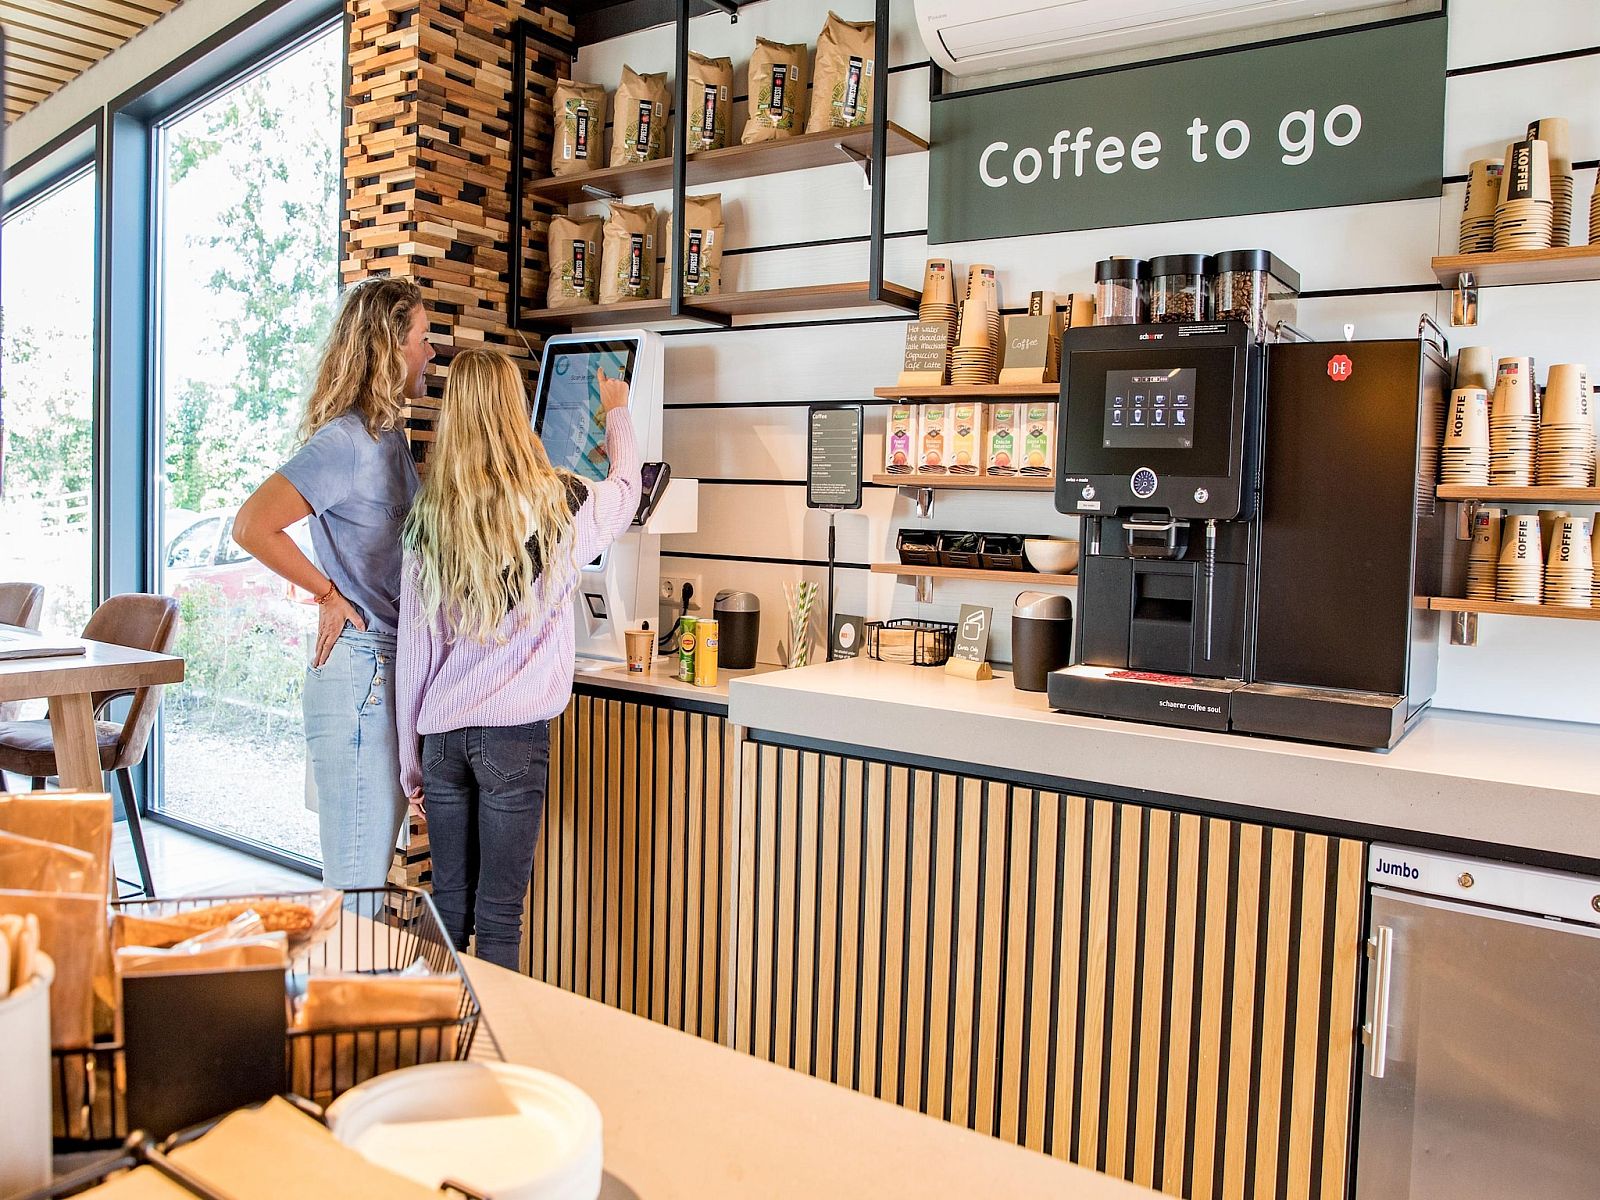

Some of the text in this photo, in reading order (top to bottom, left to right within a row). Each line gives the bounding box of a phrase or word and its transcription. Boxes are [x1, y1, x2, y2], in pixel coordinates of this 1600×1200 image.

[978, 103, 1363, 188] Coffee to go
[1516, 147, 1530, 192] KOFFIE
[908, 325, 919, 333] Hot
[1011, 338, 1040, 351] Coffee
[905, 351, 939, 361] Cappuccino
[1579, 371, 1588, 416] KOFFIE
[1453, 395, 1467, 438] KOFFIE
[1517, 520, 1528, 559] KOFFIE
[1559, 522, 1573, 562] KOFFIE
[1158, 699, 1222, 714] schaerer coffee soul
[1375, 858, 1420, 880] Jumbo
